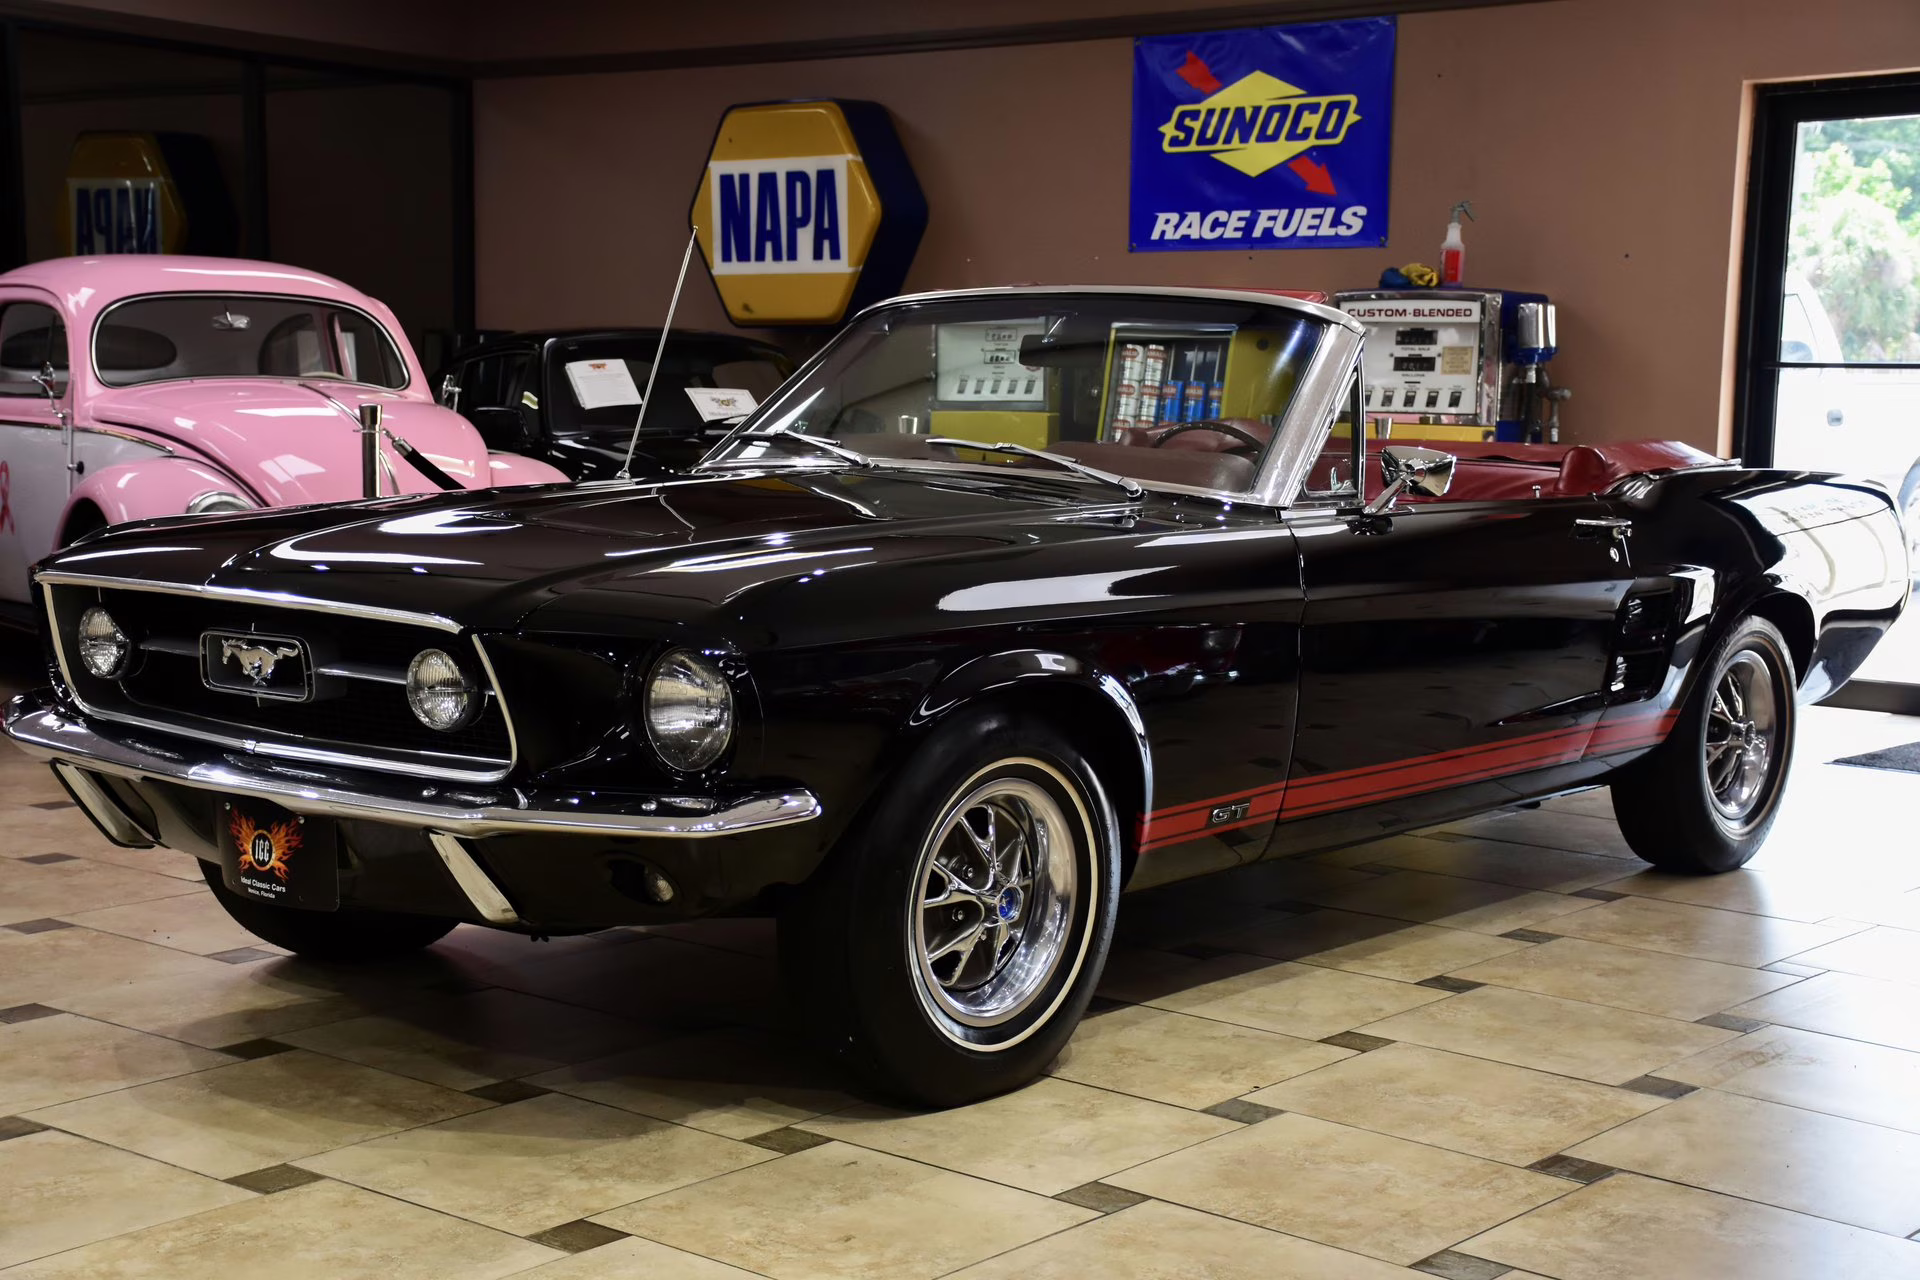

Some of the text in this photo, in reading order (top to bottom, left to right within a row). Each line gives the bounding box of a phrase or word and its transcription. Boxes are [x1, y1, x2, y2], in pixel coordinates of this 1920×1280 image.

[1168, 100, 1352, 147] SUNOCO
[719, 168, 841, 263] NAPA
[1150, 206, 1367, 240] RACE FUELS
[1212, 803, 1250, 823] GT
[255, 839, 269, 862] ICC
[240, 876, 286, 893] Ideal Classic Cars
[260, 890, 276, 899] Florida
